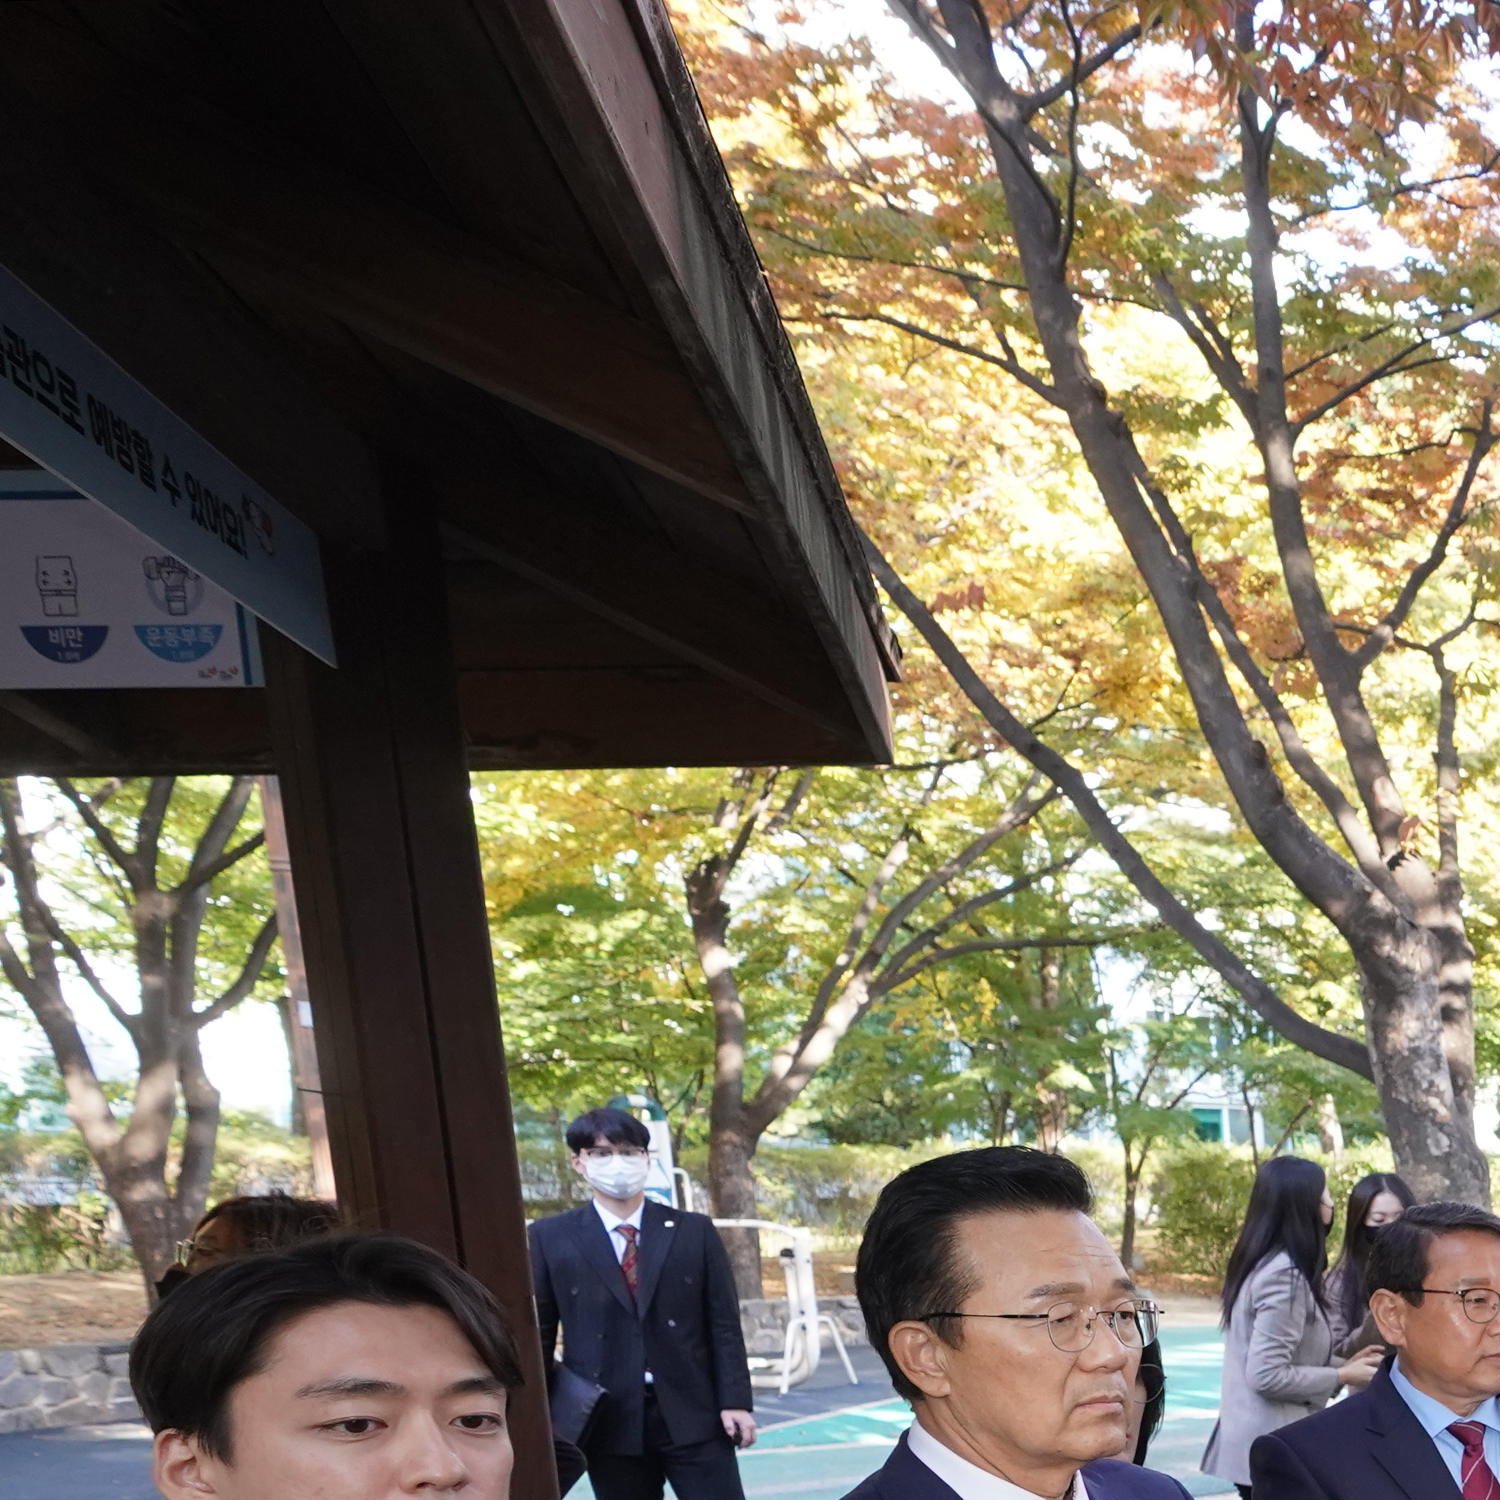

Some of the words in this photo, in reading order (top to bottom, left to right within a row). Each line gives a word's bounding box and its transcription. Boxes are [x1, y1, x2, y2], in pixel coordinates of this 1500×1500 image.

[0, 324, 86, 436] 관으로
[87, 393, 157, 493] 예방할
[161, 454, 182, 508] 수
[48, 627, 83, 648] 비만
